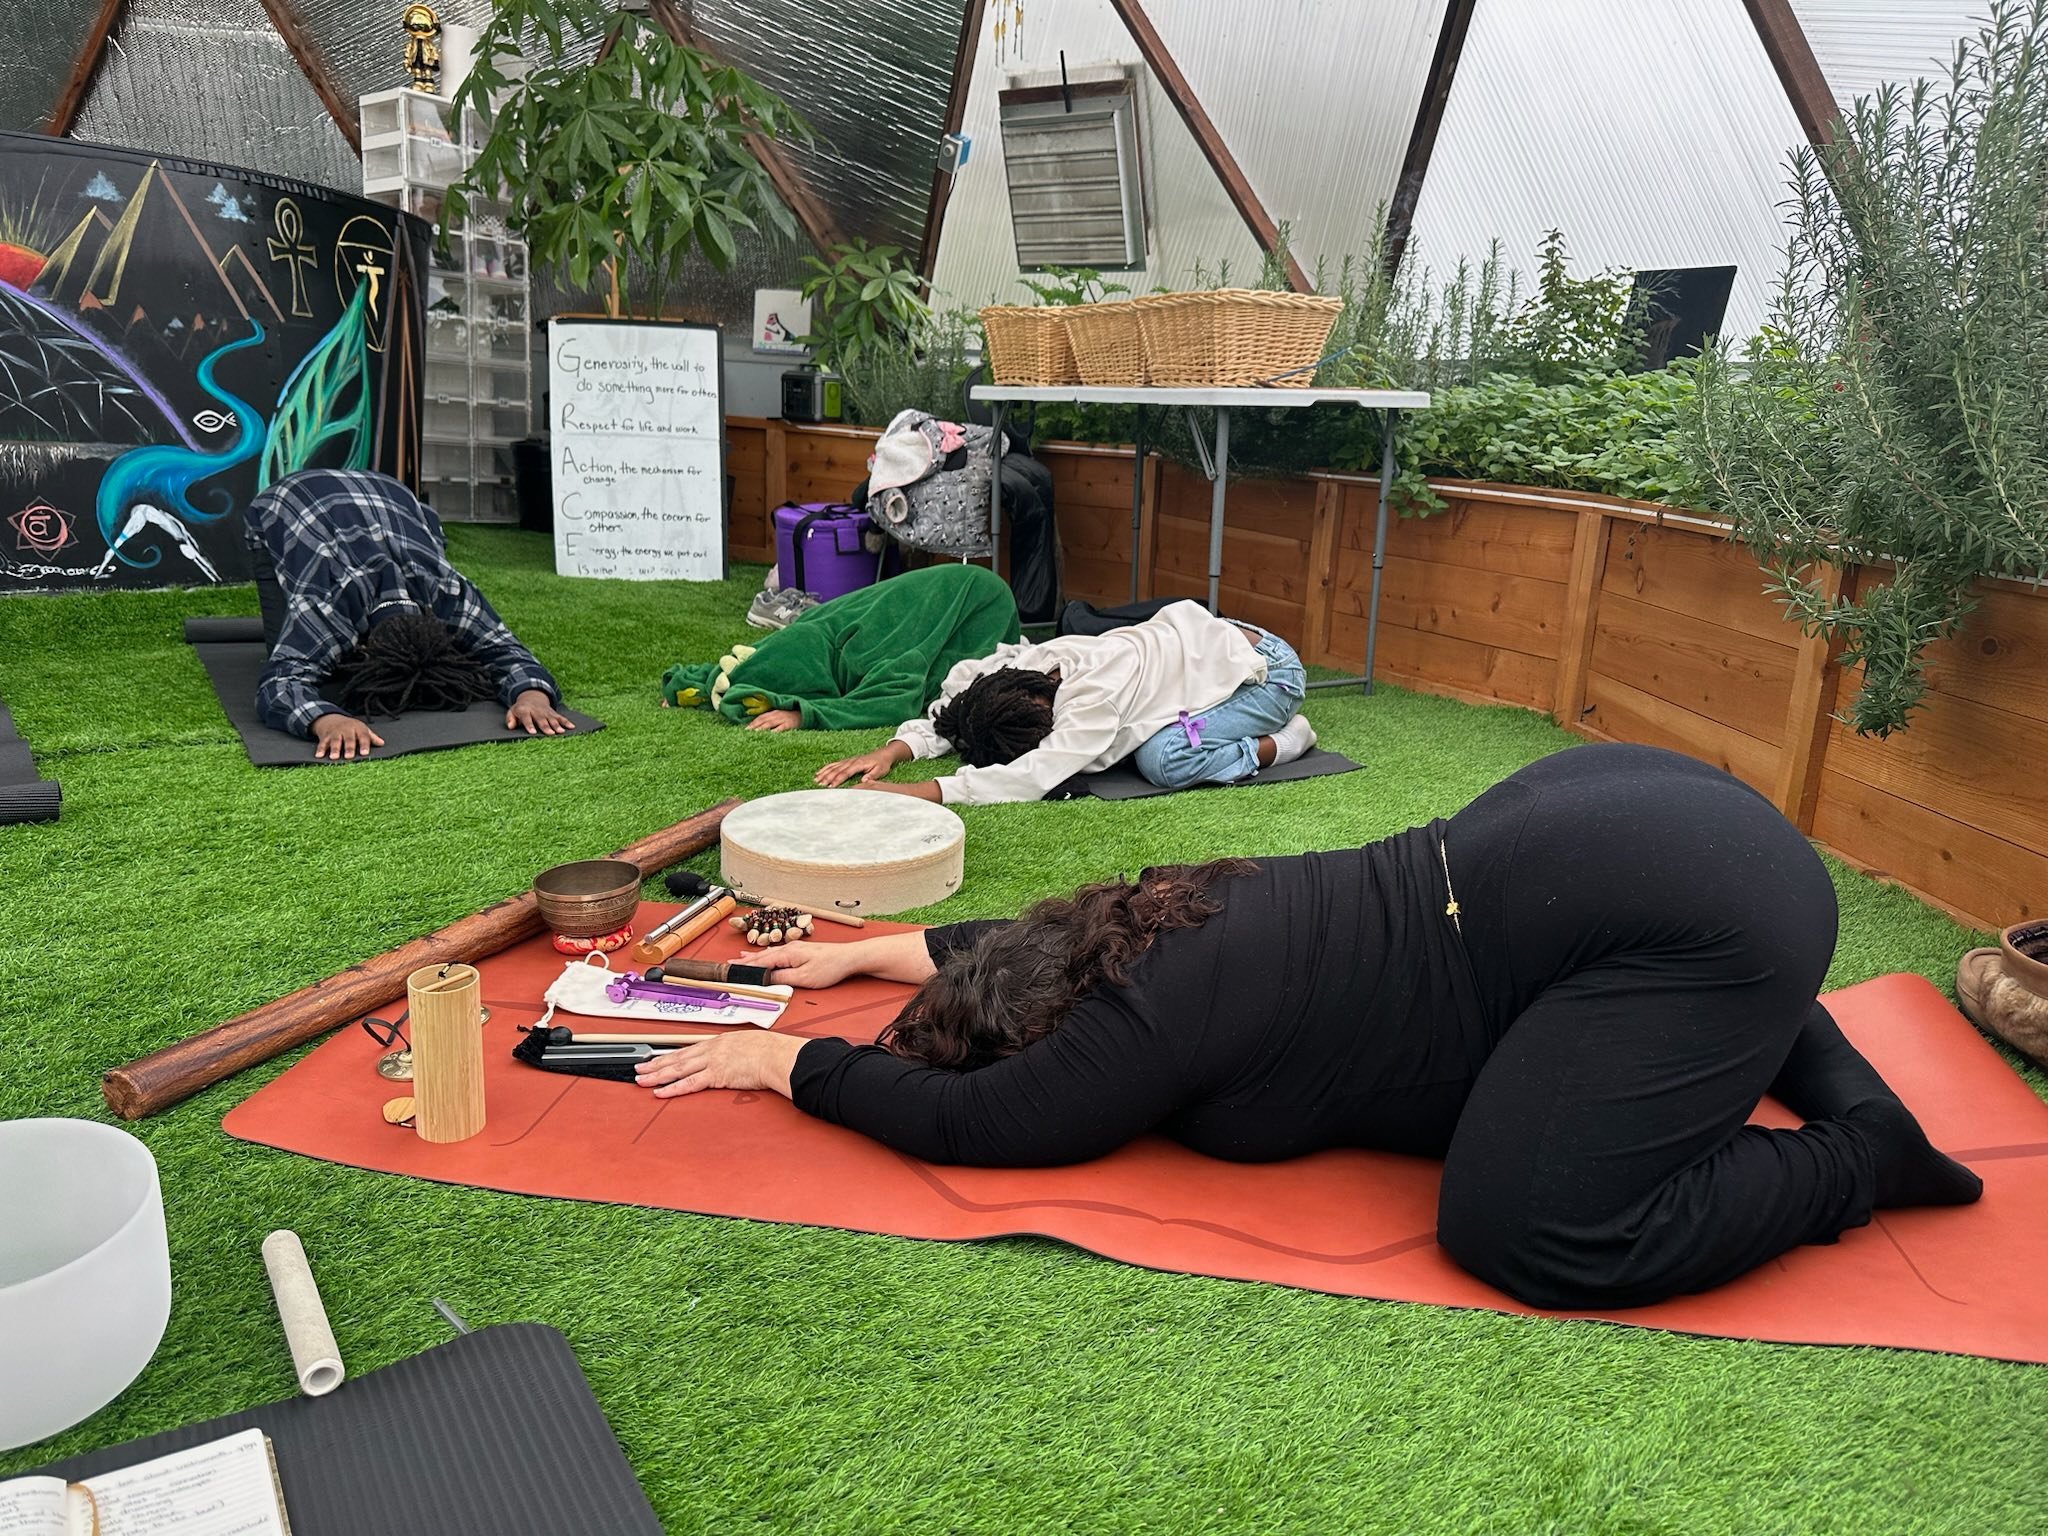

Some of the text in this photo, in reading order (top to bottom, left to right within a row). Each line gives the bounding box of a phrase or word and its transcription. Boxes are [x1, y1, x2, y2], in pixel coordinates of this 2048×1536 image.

[557, 338, 648, 378] Generosity,
[649, 356, 668, 370] the
[694, 362, 705, 372] to
[576, 378, 718, 405] do something more for others
[561, 402, 618, 433] Respect
[621, 417, 635, 431] for
[639, 420, 654, 432] life
[656, 424, 672, 433] and
[562, 446, 702, 476] Action, the mechanism for
[583, 476, 617, 487] change
[561, 492, 640, 522] Compassion,
[641, 507, 658, 521] the
[695, 511, 711, 523] for
[621, 545, 633, 555] the
[634, 547, 662, 559] energy
[677, 549, 690, 559] put
[692, 550, 708, 558] out
